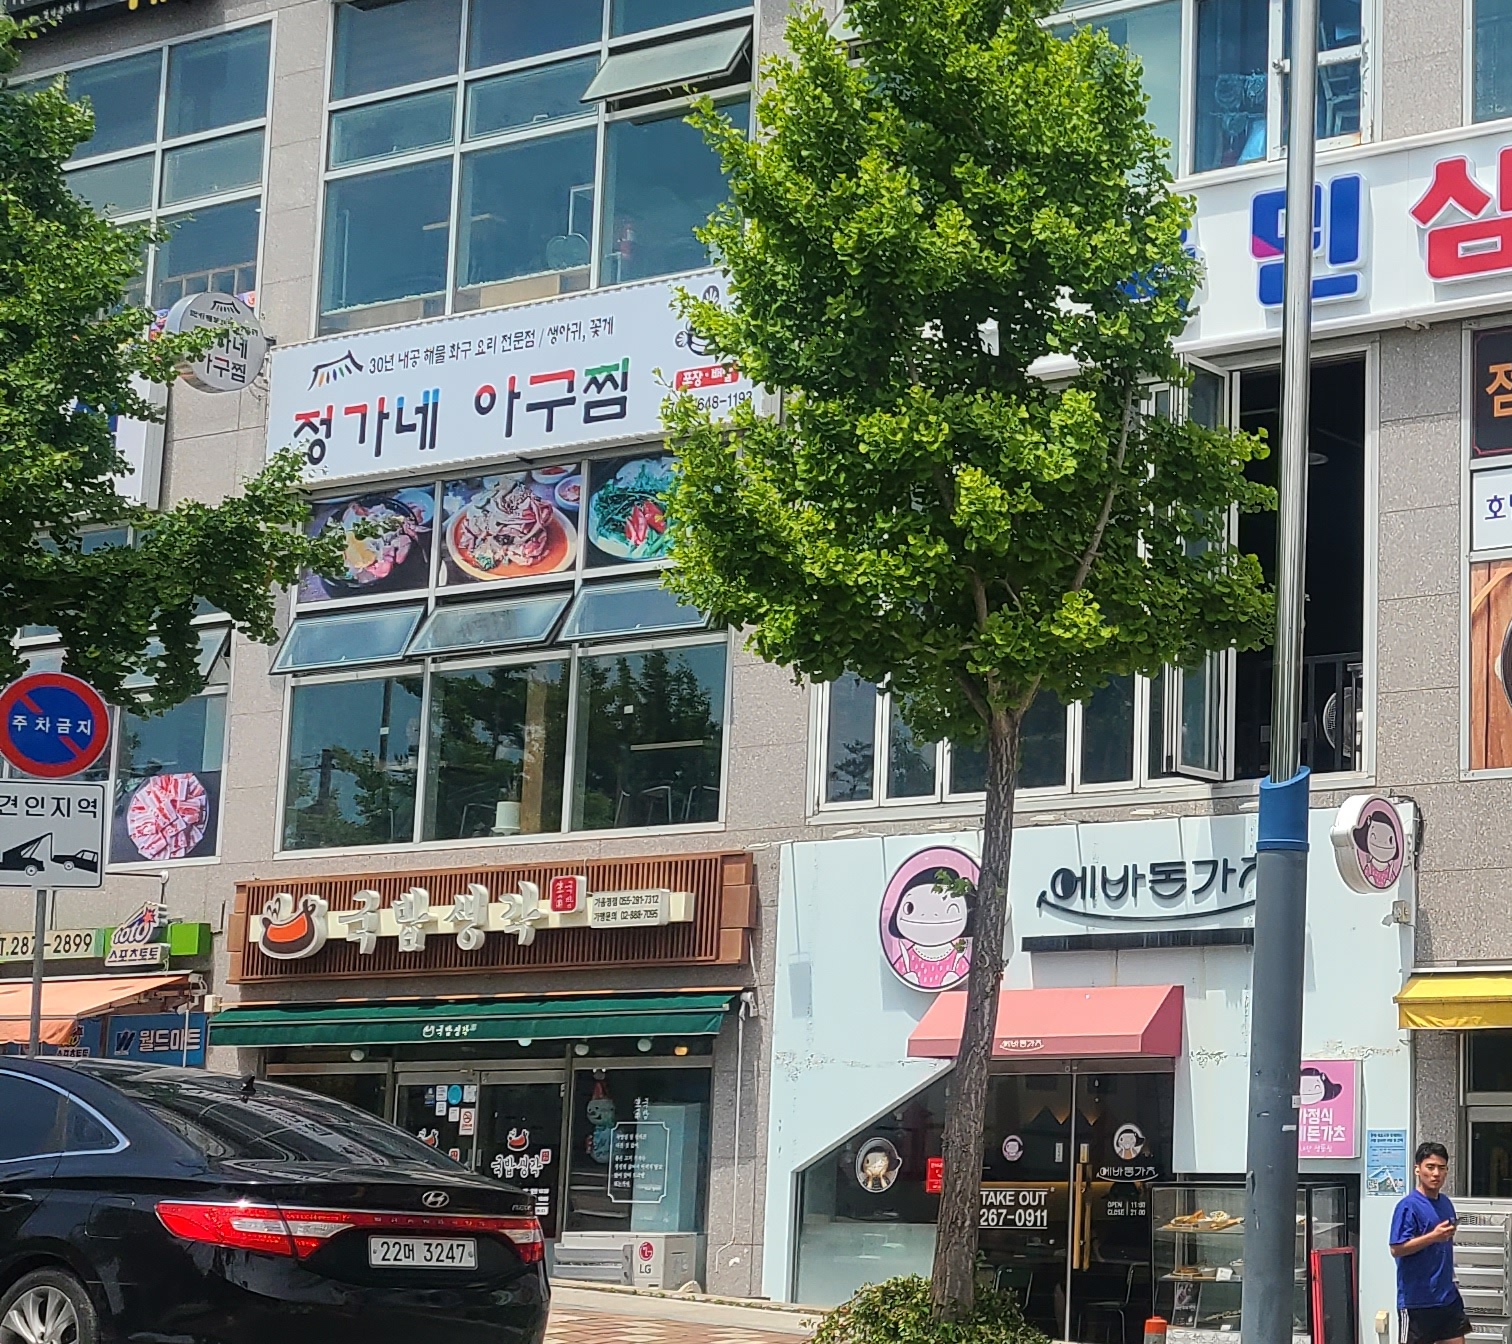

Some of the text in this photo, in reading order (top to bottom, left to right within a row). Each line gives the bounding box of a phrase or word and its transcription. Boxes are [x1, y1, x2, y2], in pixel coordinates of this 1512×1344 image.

[369, 353, 394, 374] 30년
[398, 348, 420, 370] 내공
[424, 344, 446, 366] 해물
[474, 337, 497, 357] 요리
[500, 329, 537, 353] 전문점
[589, 315, 615, 338] 꽃게
[294, 357, 630, 466] 정가네 아구찜
[12, 714, 92, 735] 주차금지
[0, 794, 97, 818] 견인지역
[338, 881, 546, 954] 국밥생각
[1300, 1125, 1346, 1142] 돈가츠
[980, 1191, 1048, 1206] TAKE OUT
[980, 1209, 1048, 1227] 267-0911
[424, 1242, 466, 1263] 3247
[639, 1263, 652, 1275] LG
